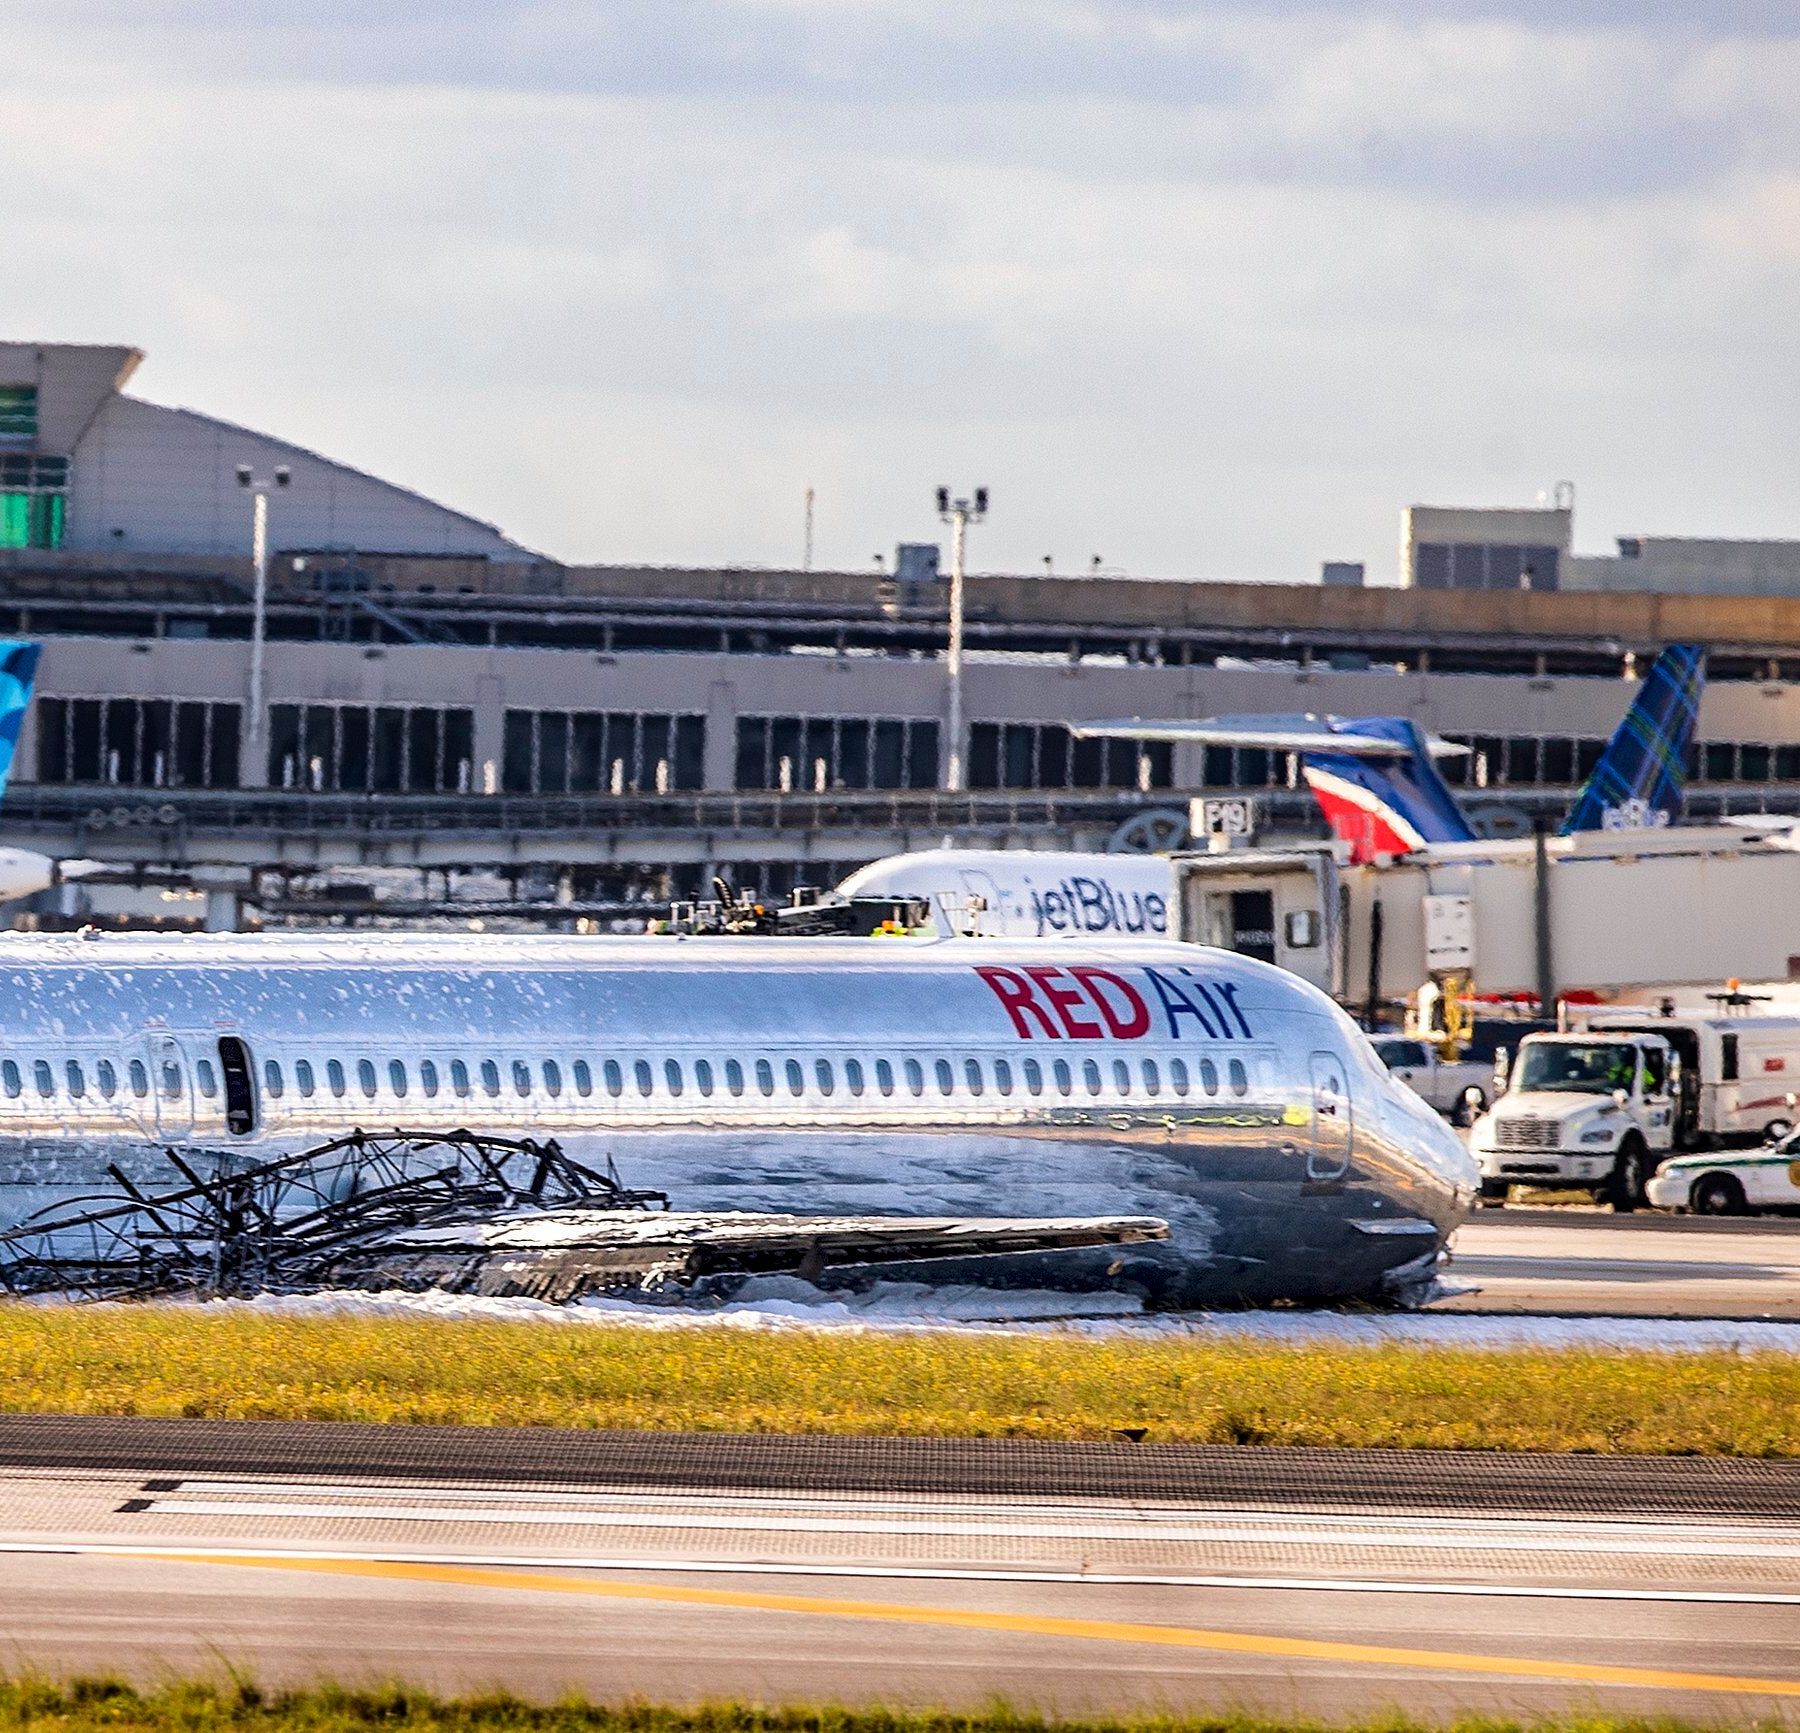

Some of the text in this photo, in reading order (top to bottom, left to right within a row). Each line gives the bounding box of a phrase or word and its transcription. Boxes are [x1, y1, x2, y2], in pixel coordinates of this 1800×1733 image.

[1024, 873, 1167, 937] jetBlue
[973, 966, 1253, 1040] RED Air
